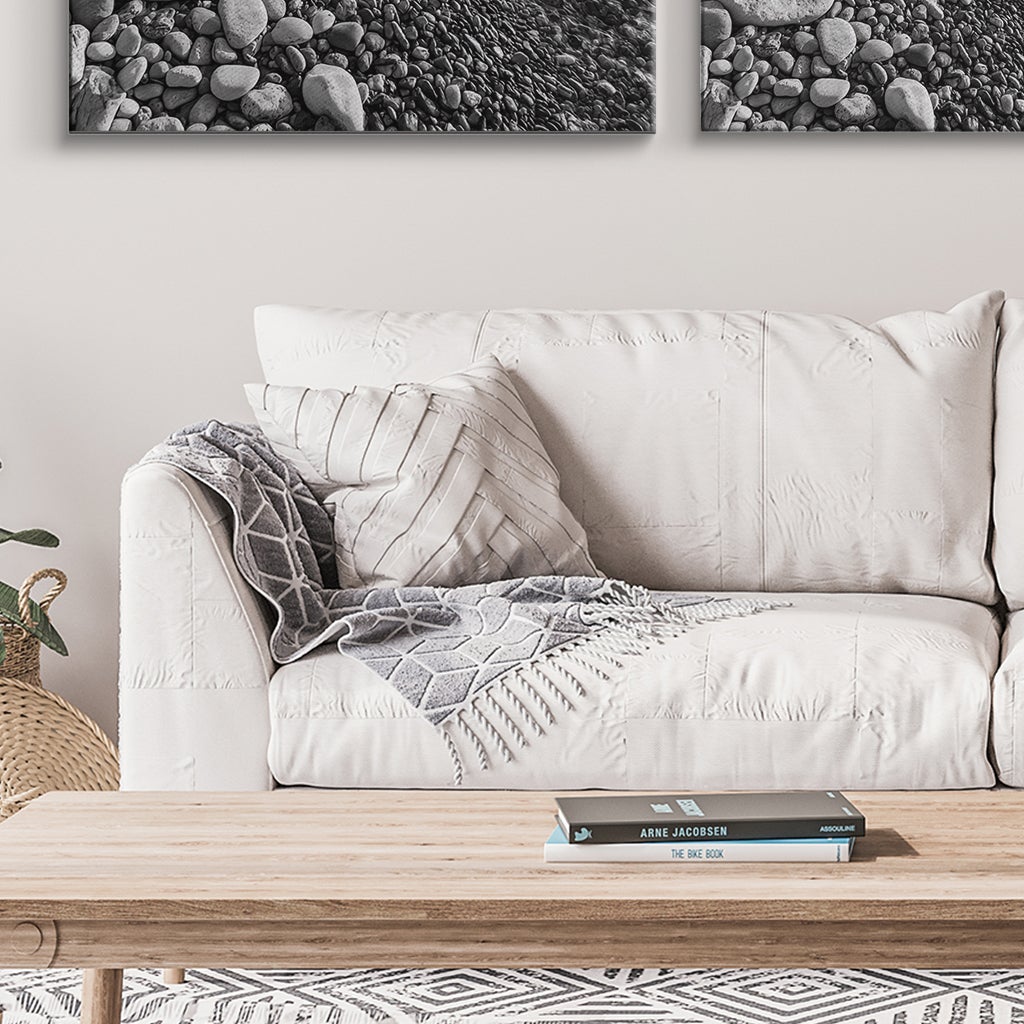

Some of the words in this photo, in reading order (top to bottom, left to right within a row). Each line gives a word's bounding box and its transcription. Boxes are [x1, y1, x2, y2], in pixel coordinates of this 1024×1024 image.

[640, 827, 669, 838] ARNE
[672, 826, 728, 837] JACOBSEN
[819, 825, 856, 833] ASSOULINE
[671, 848, 685, 859] THE
[687, 848, 703, 859] BIKE
[705, 848, 724, 859] BOOK
